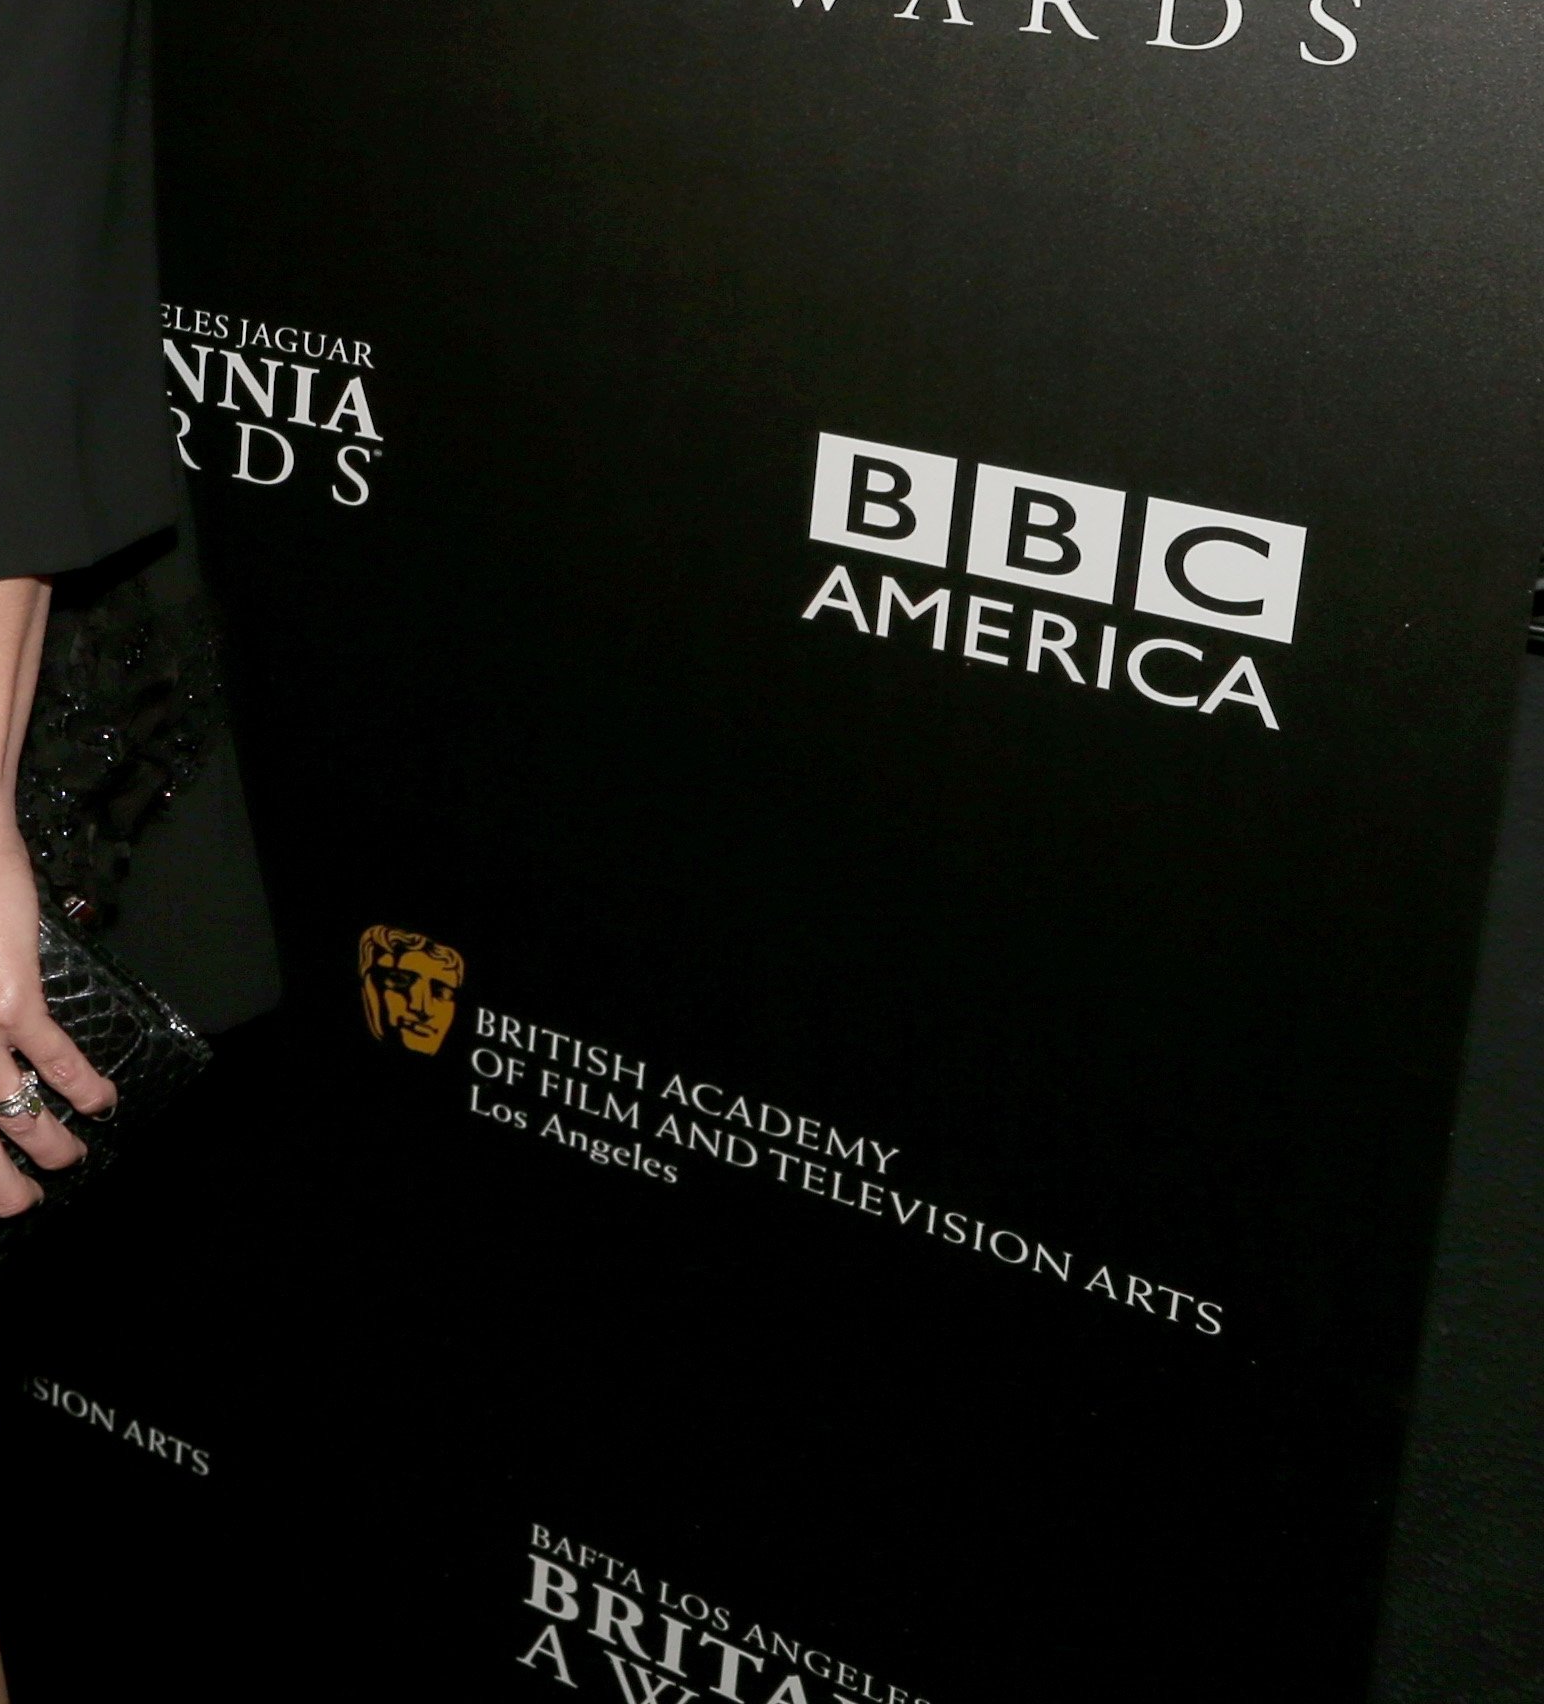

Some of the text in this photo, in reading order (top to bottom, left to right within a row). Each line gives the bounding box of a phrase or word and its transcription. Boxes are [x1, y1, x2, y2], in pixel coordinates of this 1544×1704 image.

[235, 318, 374, 369] JAGUAR
[845, 453, 1272, 618] BBC
[801, 564, 1280, 731] AMERICA
[470, 1084, 678, 1184] Los Angeles
[476, 1007, 900, 1174] BRITISH ACADEMY
[471, 1048, 1223, 1335] OF FILM AND TELEVISION ARTS
[122, 1419, 211, 1477] ARTS
[530, 1522, 933, 1704] BAFTA LOS ANGELE
